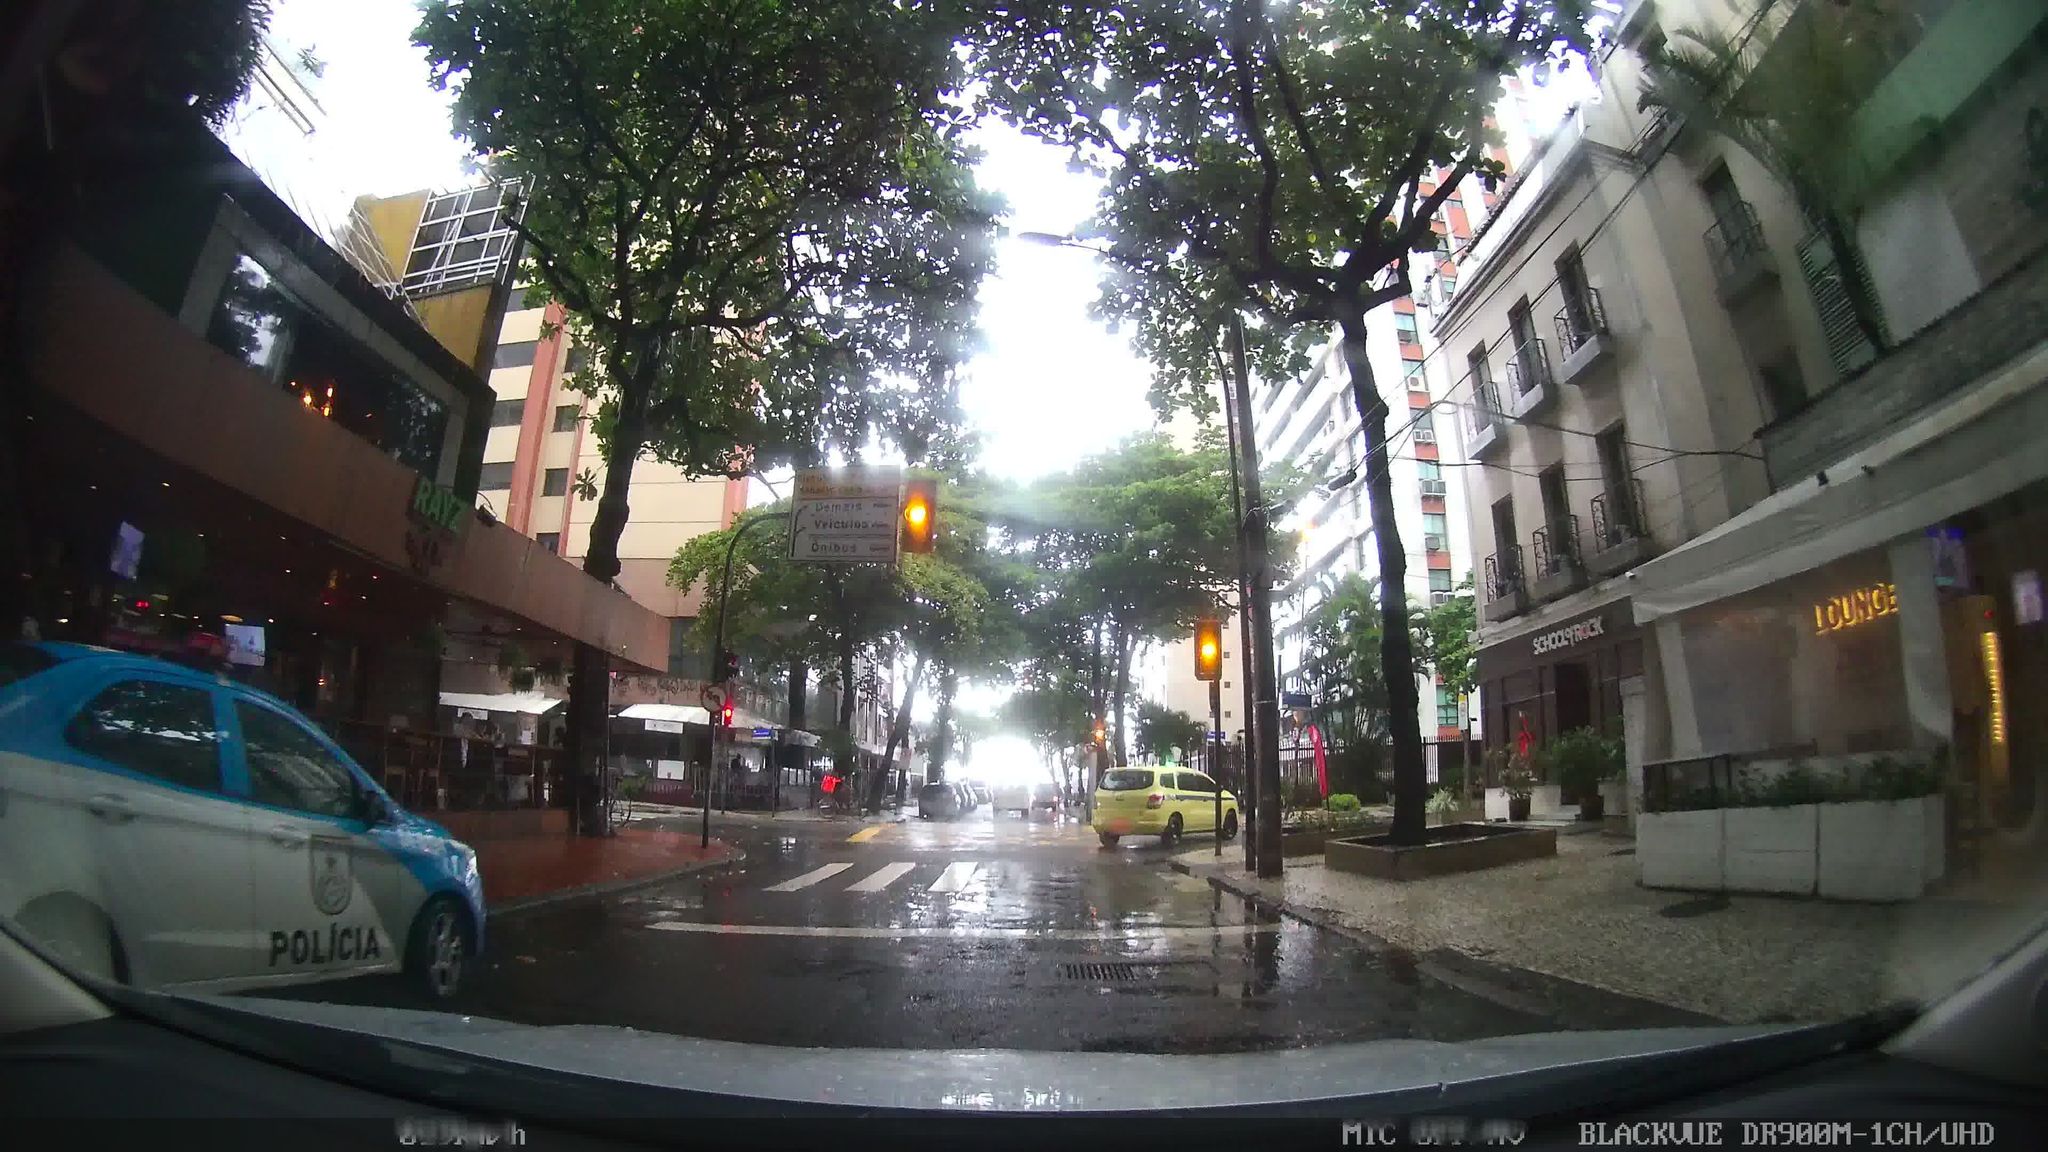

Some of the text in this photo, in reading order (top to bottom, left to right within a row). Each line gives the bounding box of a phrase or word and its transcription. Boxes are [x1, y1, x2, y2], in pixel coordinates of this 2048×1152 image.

[811, 540, 857, 553] Ônibus
[1814, 582, 1899, 635] LOUNGE
[268, 922, 381, 967] POLÍCIA
